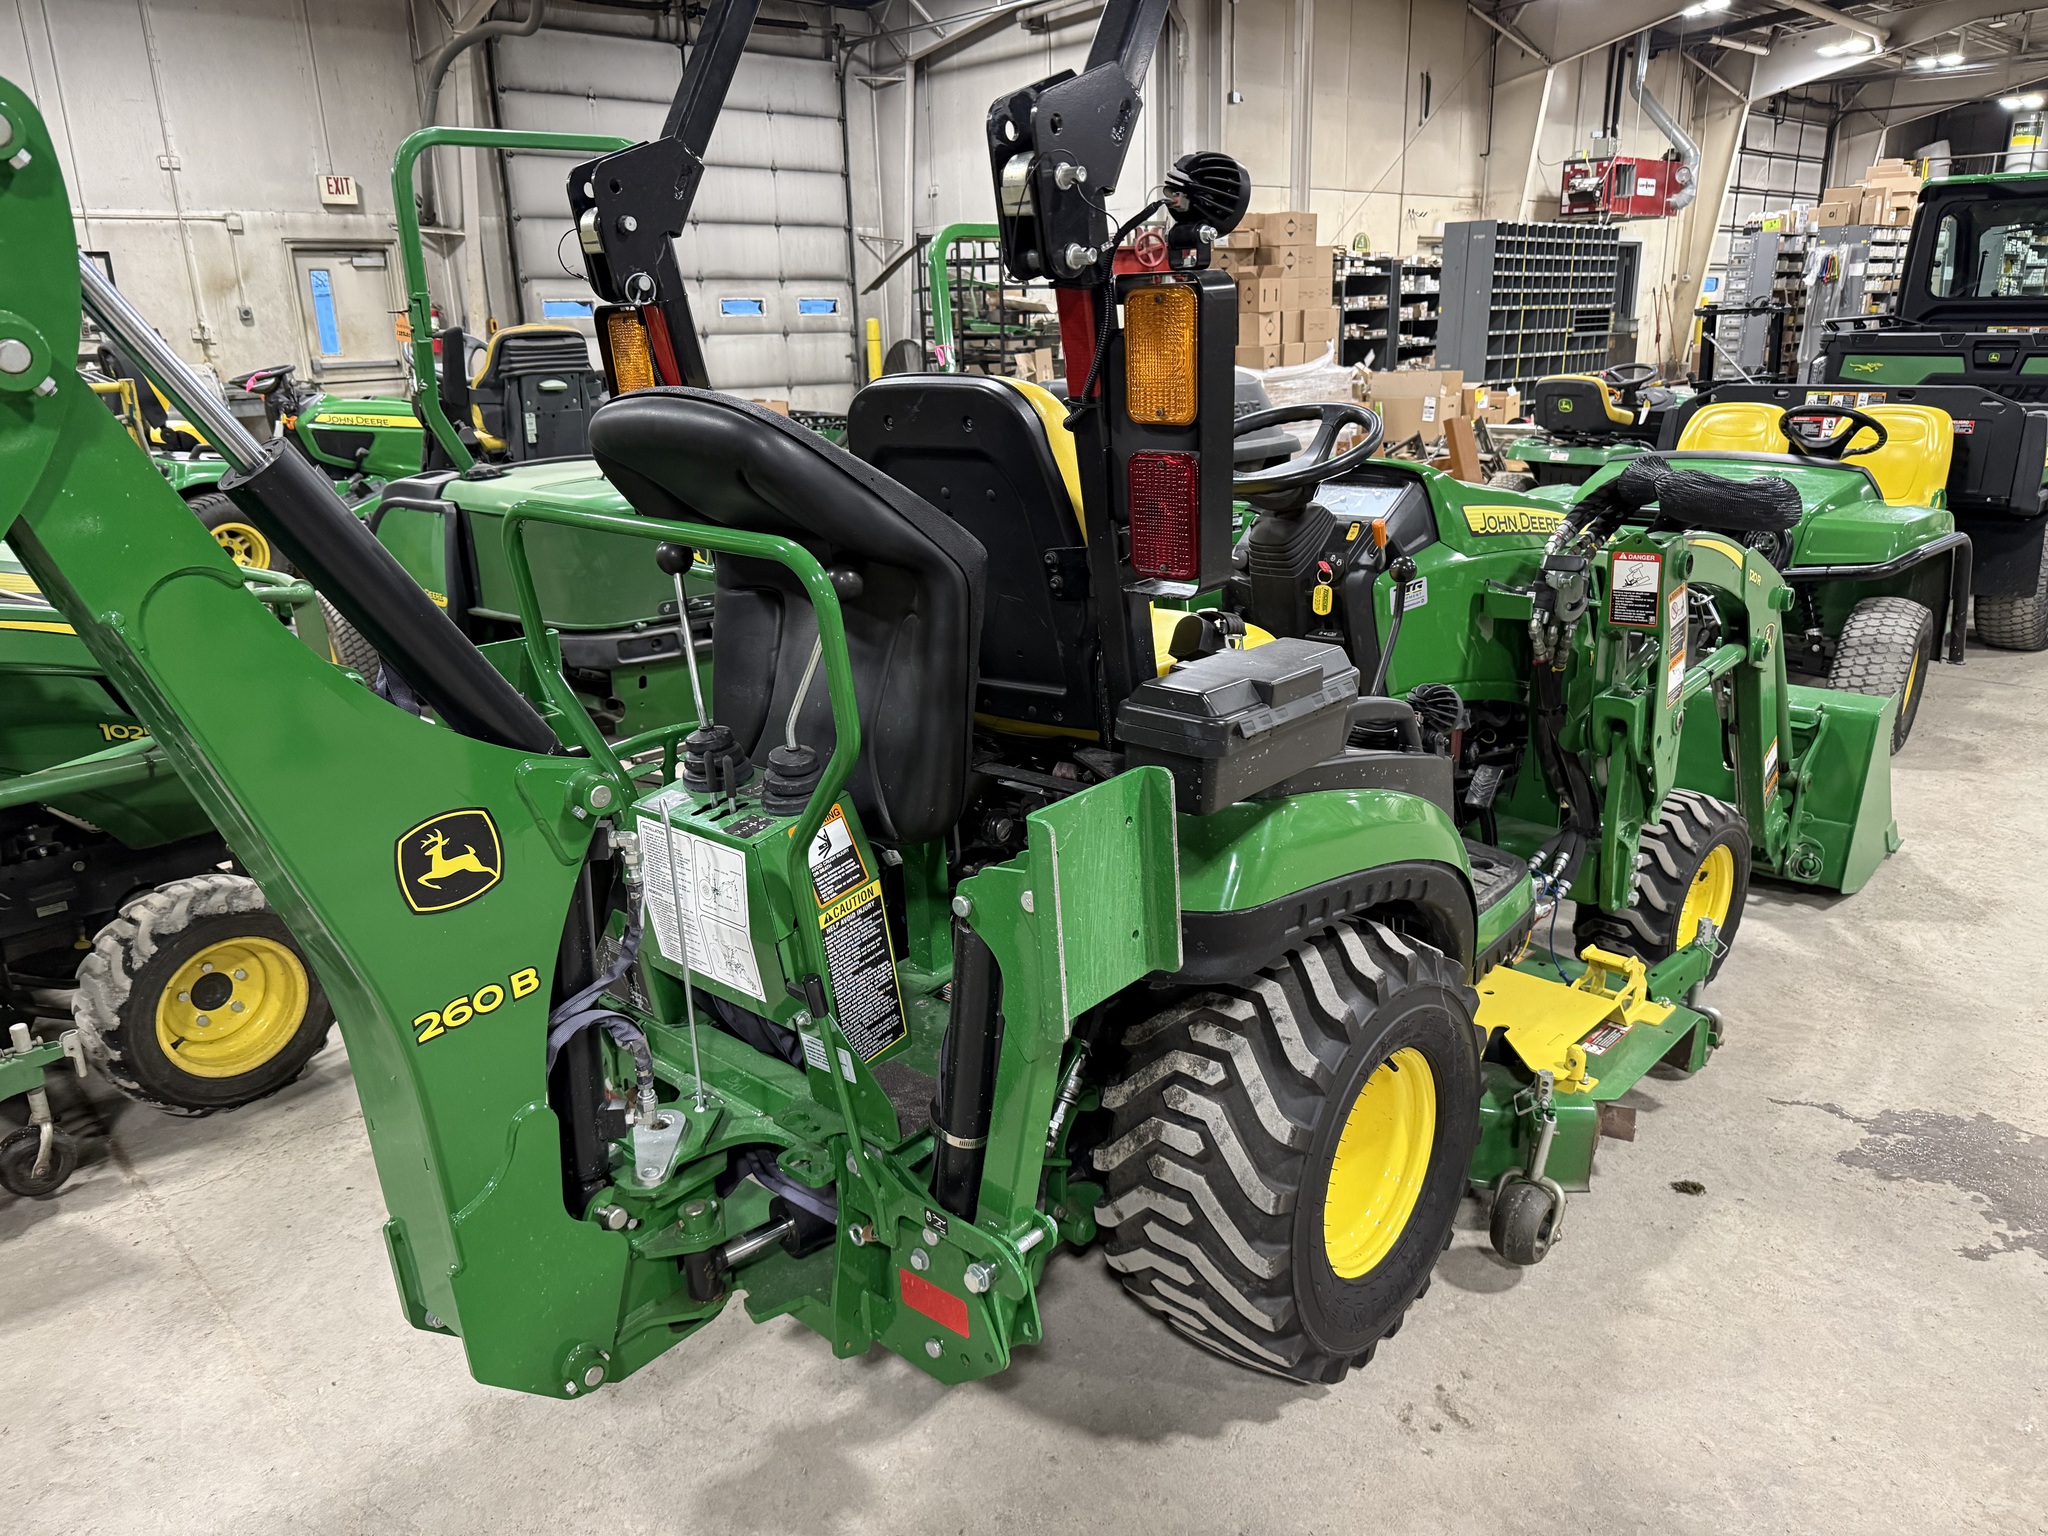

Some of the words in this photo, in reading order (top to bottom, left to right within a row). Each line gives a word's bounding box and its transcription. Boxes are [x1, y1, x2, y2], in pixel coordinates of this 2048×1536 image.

[326, 176, 350, 195] EXIT
[327, 415, 354, 424] JOHN
[356, 416, 389, 426] DEERE
[1480, 513, 1516, 530] JOHN
[833, 886, 874, 918] CAUTION
[826, 921, 840, 934] HELP
[840, 912, 856, 925] AVOID
[856, 900, 875, 916] INJURY
[411, 983, 506, 1046] 260
[508, 966, 541, 1002] B
